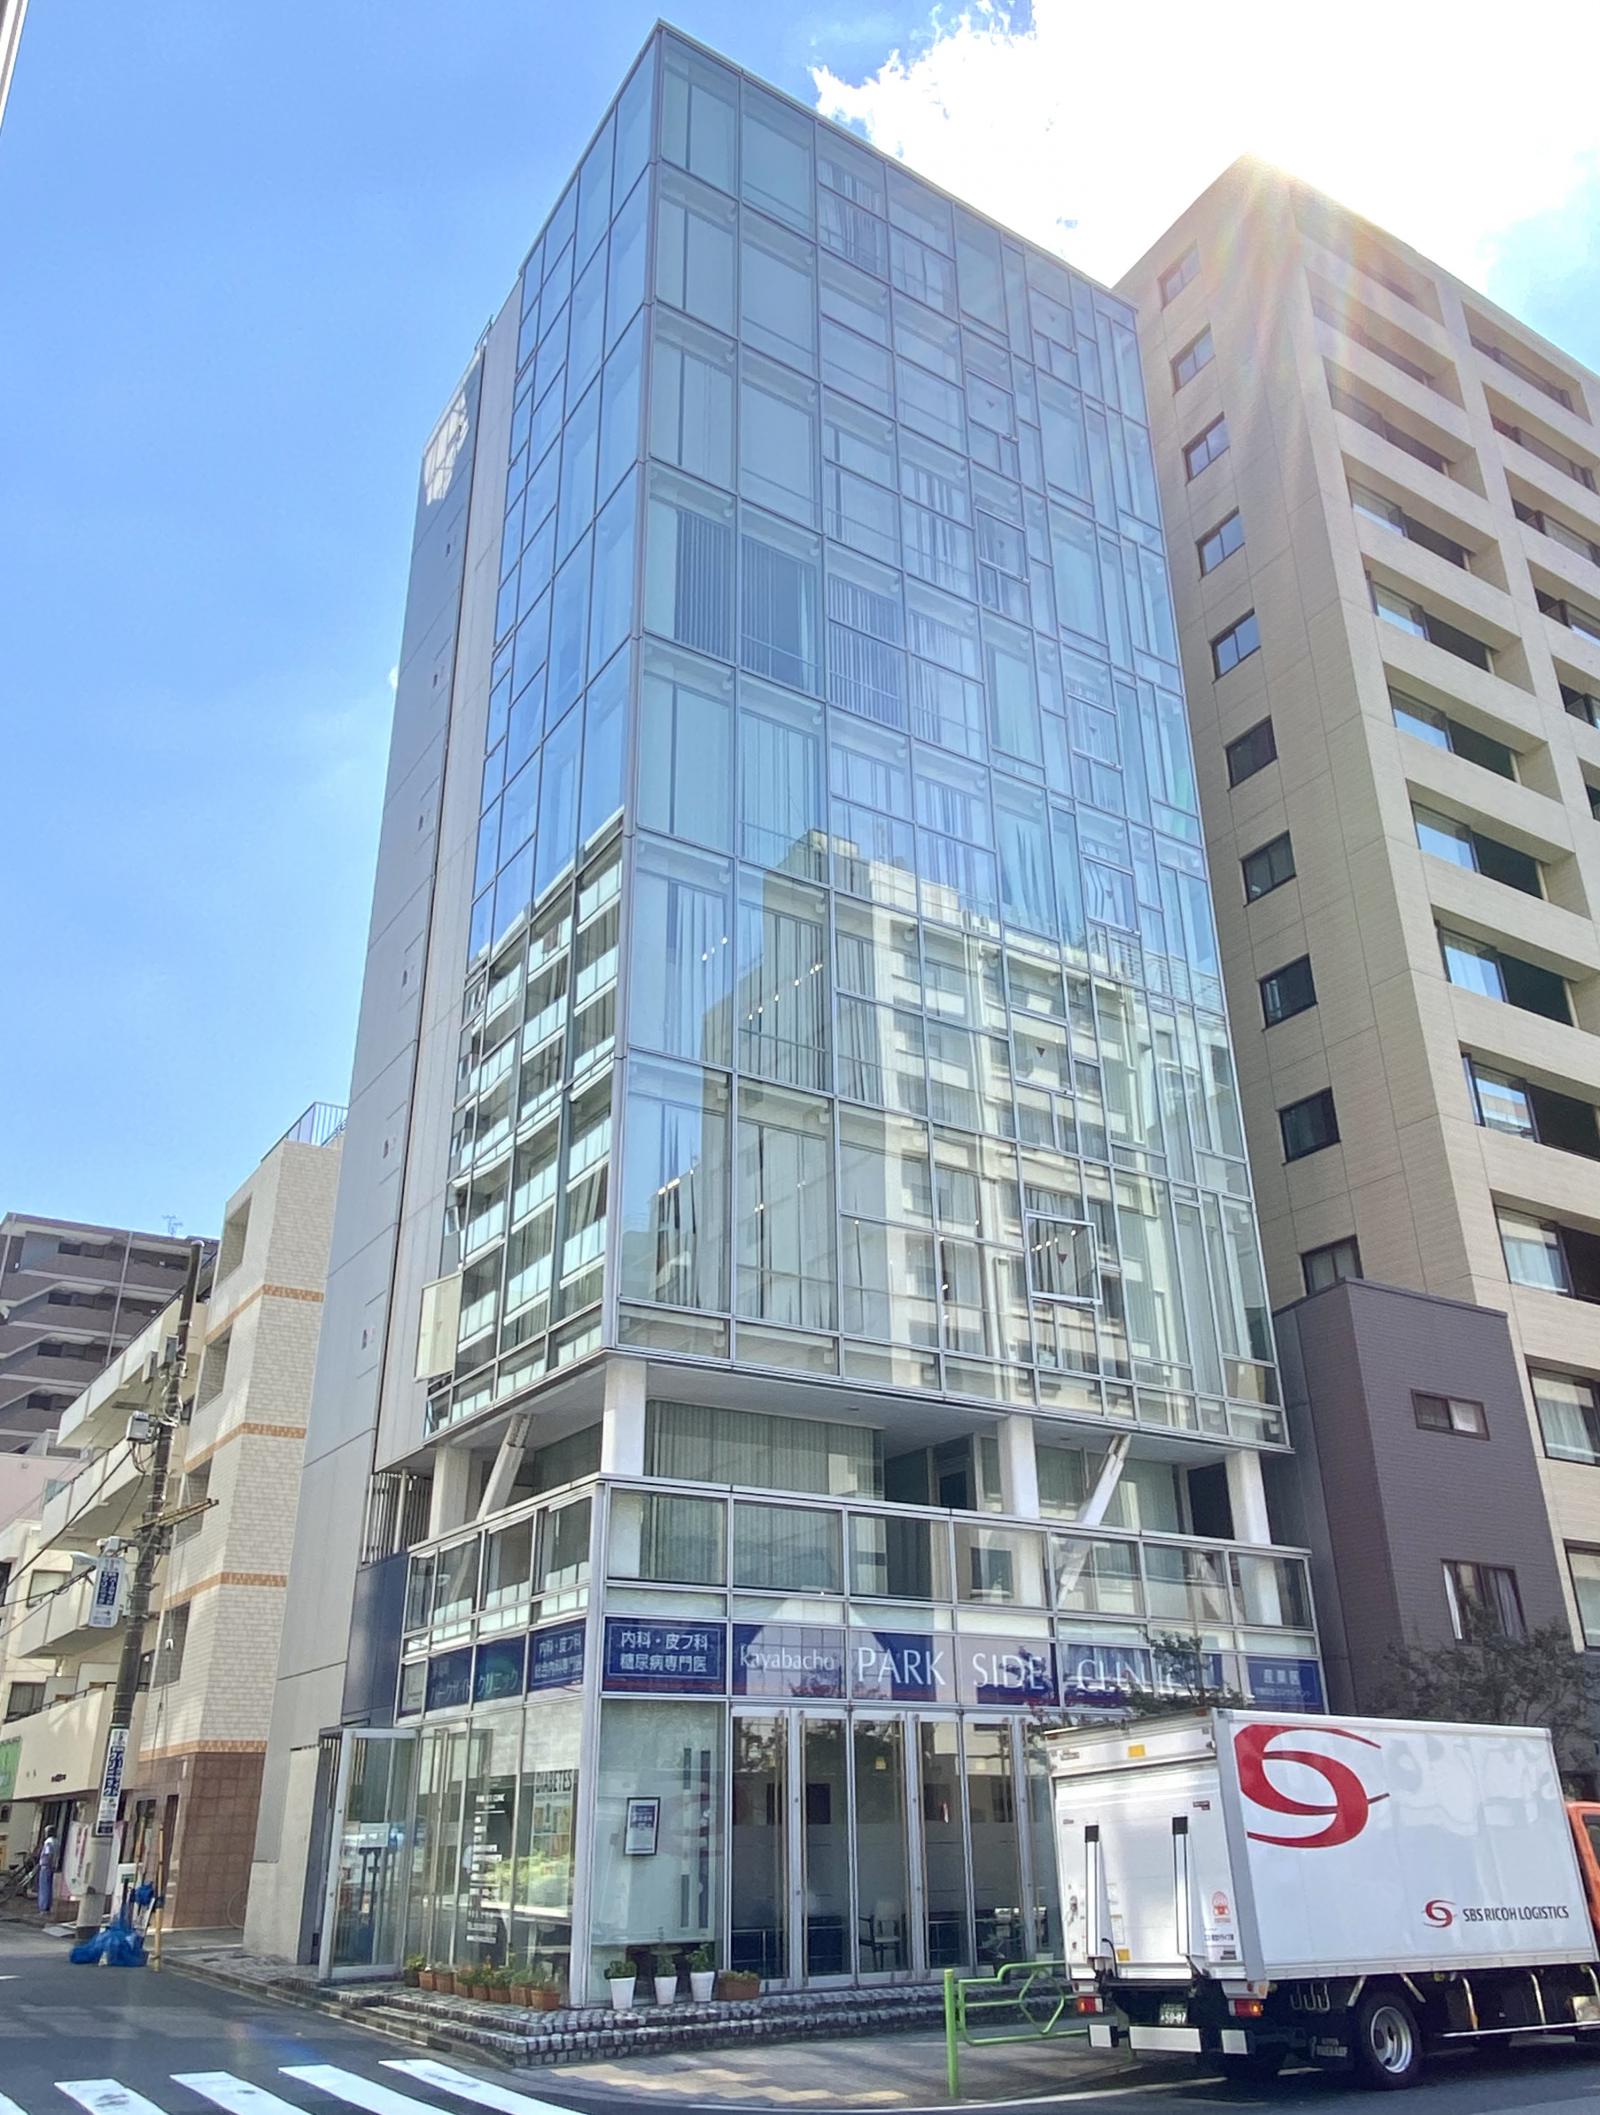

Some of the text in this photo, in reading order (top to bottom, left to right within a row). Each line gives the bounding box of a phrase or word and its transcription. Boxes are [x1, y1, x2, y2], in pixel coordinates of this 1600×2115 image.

[621, 1631, 708, 1651] 内科・皮フ科
[620, 1652, 707, 1673] 糖尿病専門医
[857, 1647, 946, 1686] PARK
[972, 1652, 1045, 1690] SIDE
[1462, 1905, 1570, 1922] SBS RICOH LOGISTICS
